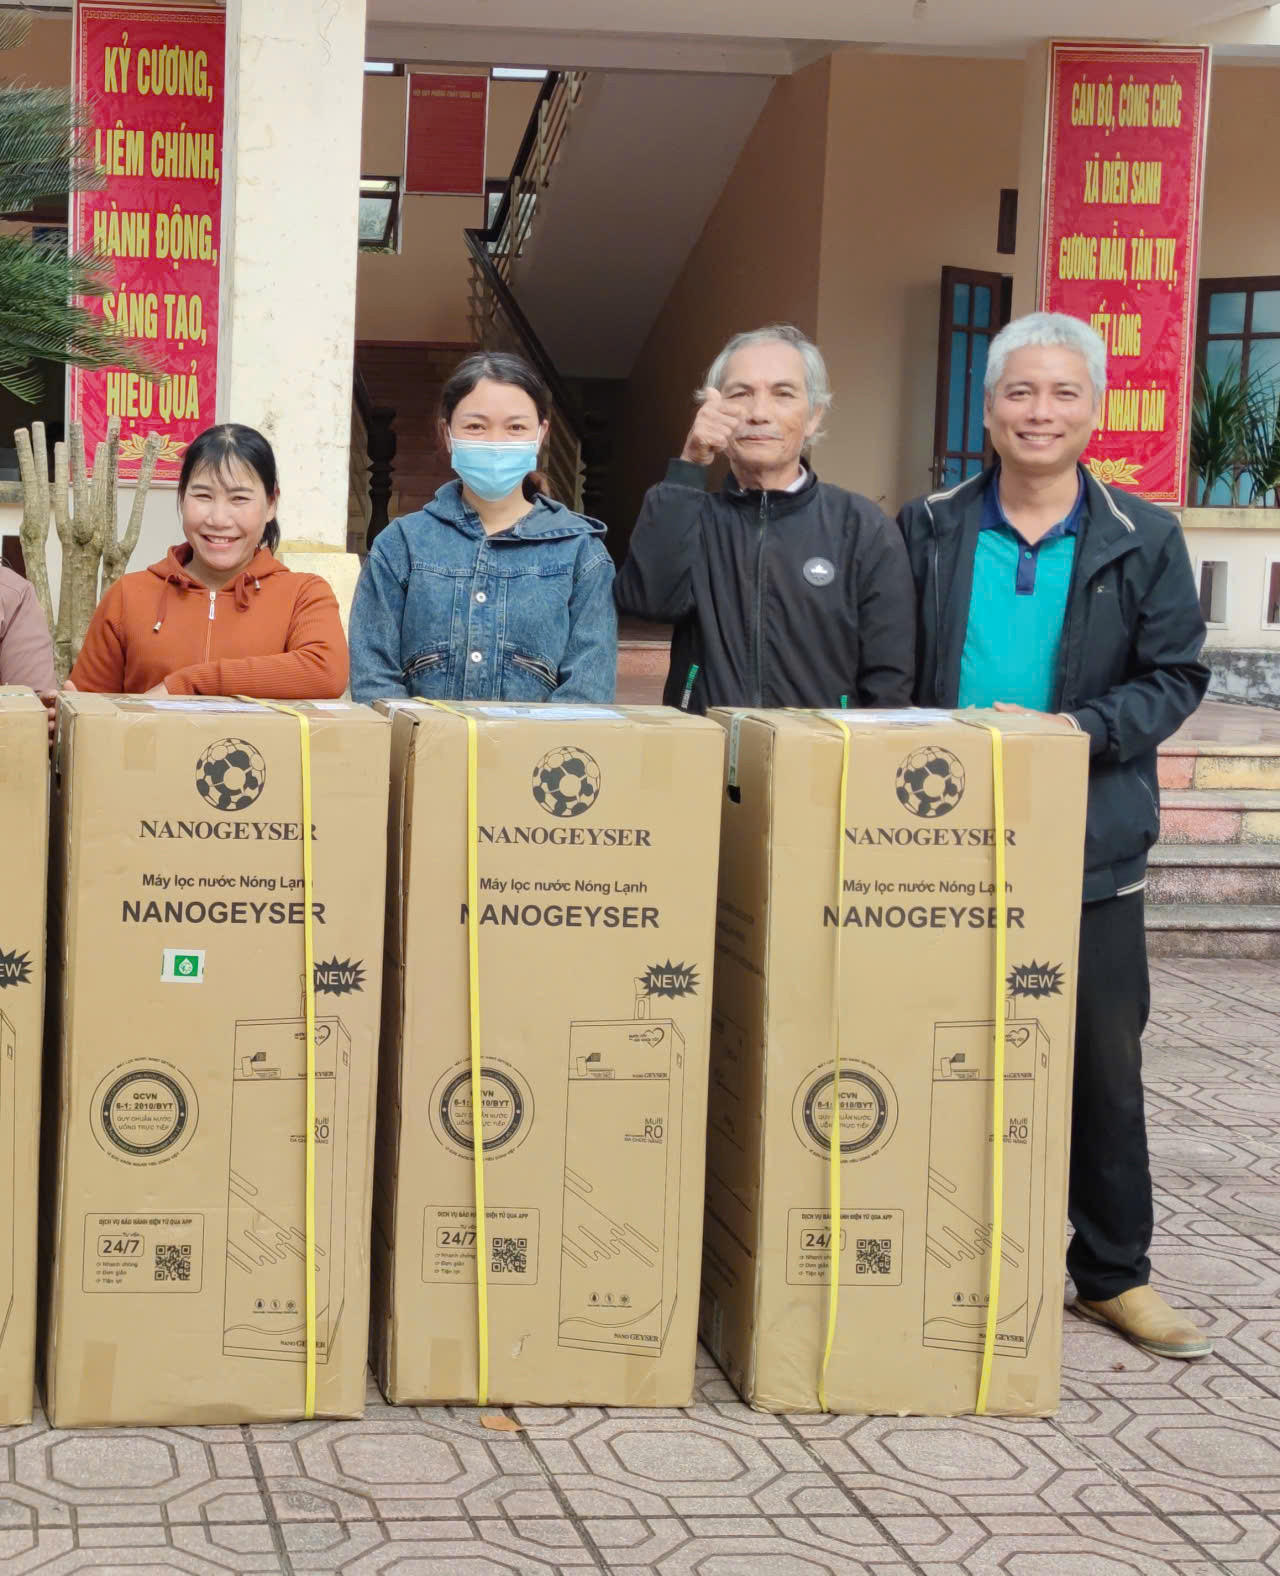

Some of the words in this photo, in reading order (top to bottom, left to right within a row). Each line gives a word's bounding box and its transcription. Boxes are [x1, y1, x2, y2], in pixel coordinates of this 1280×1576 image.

[104, 31, 132, 94] KỶ
[137, 44, 213, 103] CƯƠNG,
[1071, 74, 1095, 126] CÁN
[1097, 74, 1115, 136] BỘ,
[1118, 74, 1150, 127] CÔNG
[1152, 74, 1183, 128] CHỨC
[95, 119, 145, 177] LIÊM
[151, 122, 220, 184] CHÍNH,
[1083, 152, 1099, 203] XÃ
[1102, 152, 1129, 204] DIÊN
[1131, 161, 1162, 205] SANH
[93, 201, 150, 258] HÀNH
[156, 204, 218, 270] ĐỘNG,
[1059, 232, 1097, 280] GƯƠNG
[1099, 220, 1128, 286] MẪU,
[1131, 228, 1153, 291] TẬN
[102, 282, 159, 339] SÁNG
[164, 294, 207, 350] TẠO,
[1112, 303, 1142, 356] LÒNG
[158, 359, 200, 424] QUẢ
[1107, 380, 1140, 432] NHÂN
[1141, 380, 1166, 432] DÂN
[477, 825, 652, 847] NANOGEYSER
[845, 828, 1016, 847] NANOGEYSER
[142, 874, 171, 890] Máy
[175, 874, 195, 890] lọc
[199, 875, 236, 888] nước
[240, 876, 276, 891] Nóng
[280, 876, 313, 891] Lạn
[480, 878, 507, 893] Máy
[511, 878, 530, 894] lọc
[535, 880, 571, 892] nước
[575, 880, 610, 895] Nóng
[615, 881, 647, 896] Lạnh
[843, 879, 871, 895] Máy
[875, 879, 895, 895] lọc
[898, 880, 936, 893] nước
[939, 881, 975, 896] Nóng
[979, 881, 1013, 897] Lạh
[122, 901, 326, 924] NANOGEYSER
[823, 905, 1025, 929] NANOGEYSER
[316, 971, 356, 986] NEW
[650, 974, 690, 989] NEW
[1015, 974, 1055, 989] NEW
[133, 1092, 157, 1100] QCVN
[134, 1102, 173, 1110] 2010/BYT
[840, 1101, 873, 1110] 010/BYT
[645, 1117, 663, 1125] Multi
[1009, 1117, 1028, 1125] Multi
[644, 1125, 663, 1139] RO
[1009, 1125, 1028, 1139] RO
[103, 1239, 140, 1254] 24/7
[441, 1231, 477, 1246] 24/7
[806, 1233, 841, 1248] 24/
[296, 1340, 325, 1348] GEER
[630, 1333, 659, 1342] GEYSER
[995, 1333, 1024, 1343] GEYSER
